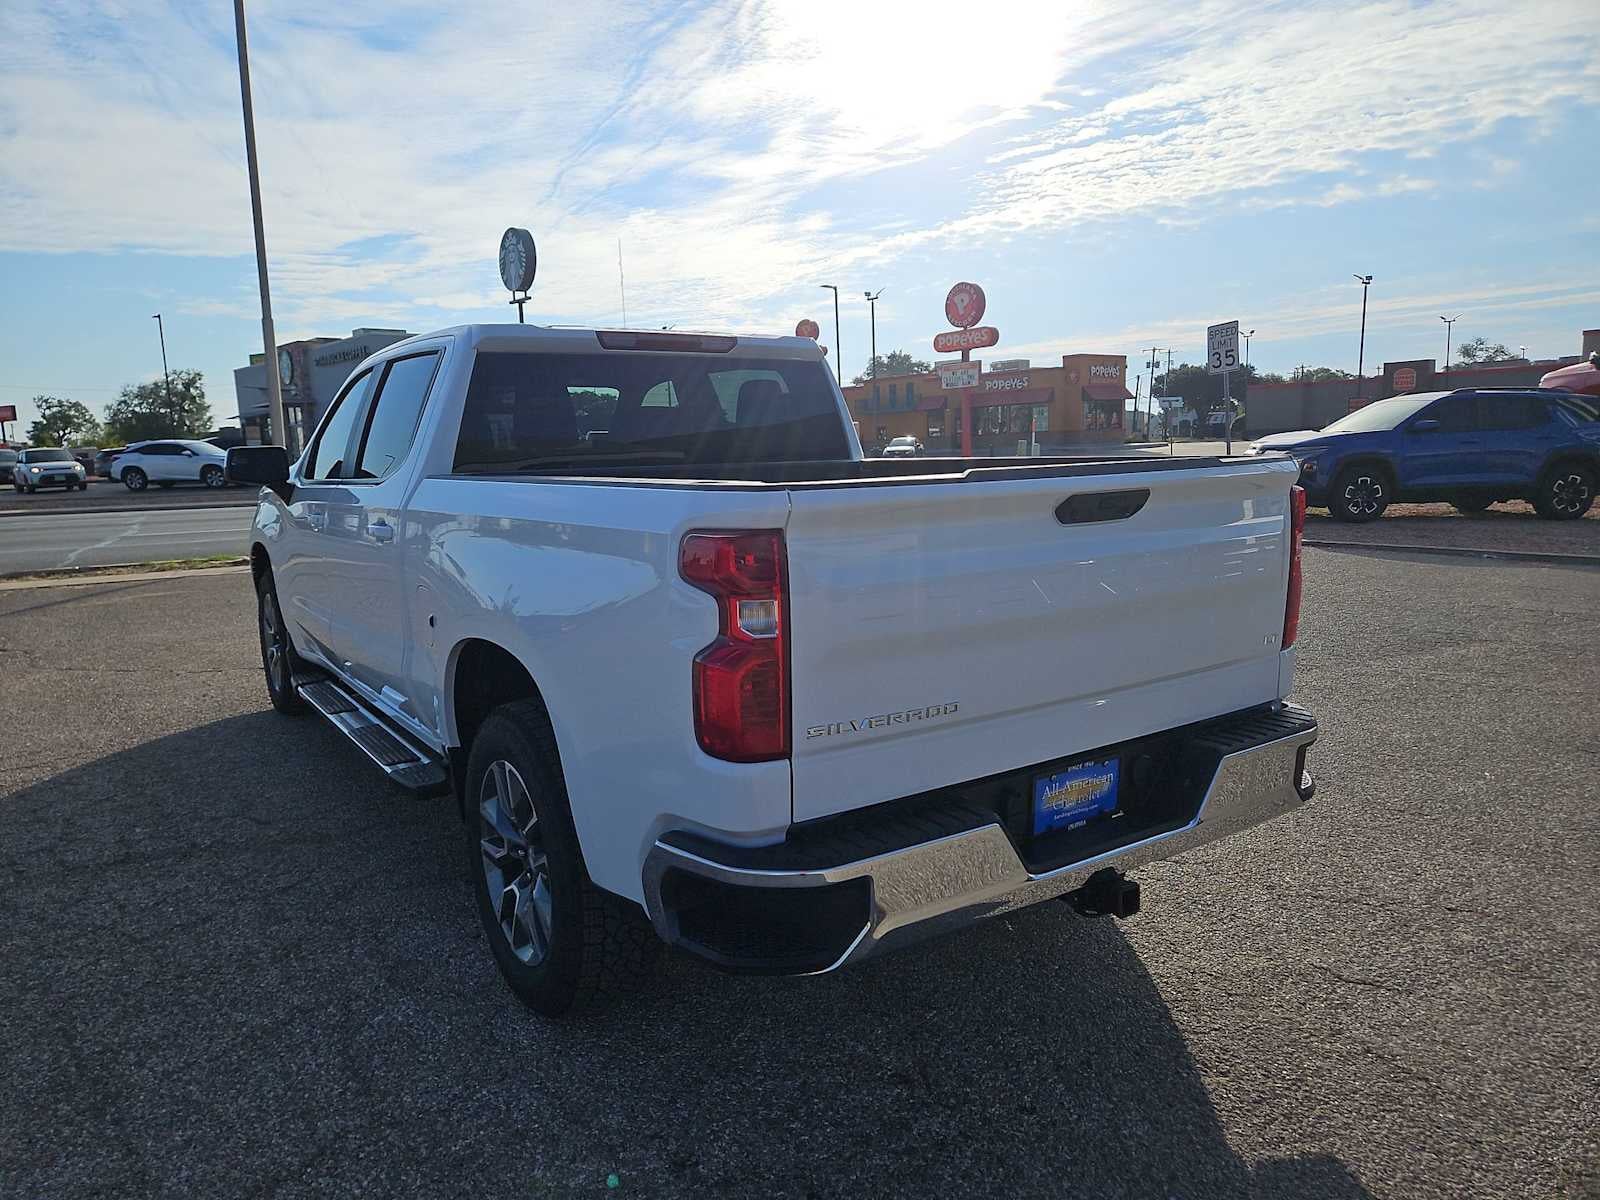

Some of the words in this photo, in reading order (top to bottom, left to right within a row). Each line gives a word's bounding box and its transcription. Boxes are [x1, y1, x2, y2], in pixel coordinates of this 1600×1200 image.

[1209, 326, 1237, 339] SPEED
[1212, 337, 1233, 350] LIMIT
[1211, 348, 1236, 369] 35
[806, 701, 960, 740] SILVERADO
